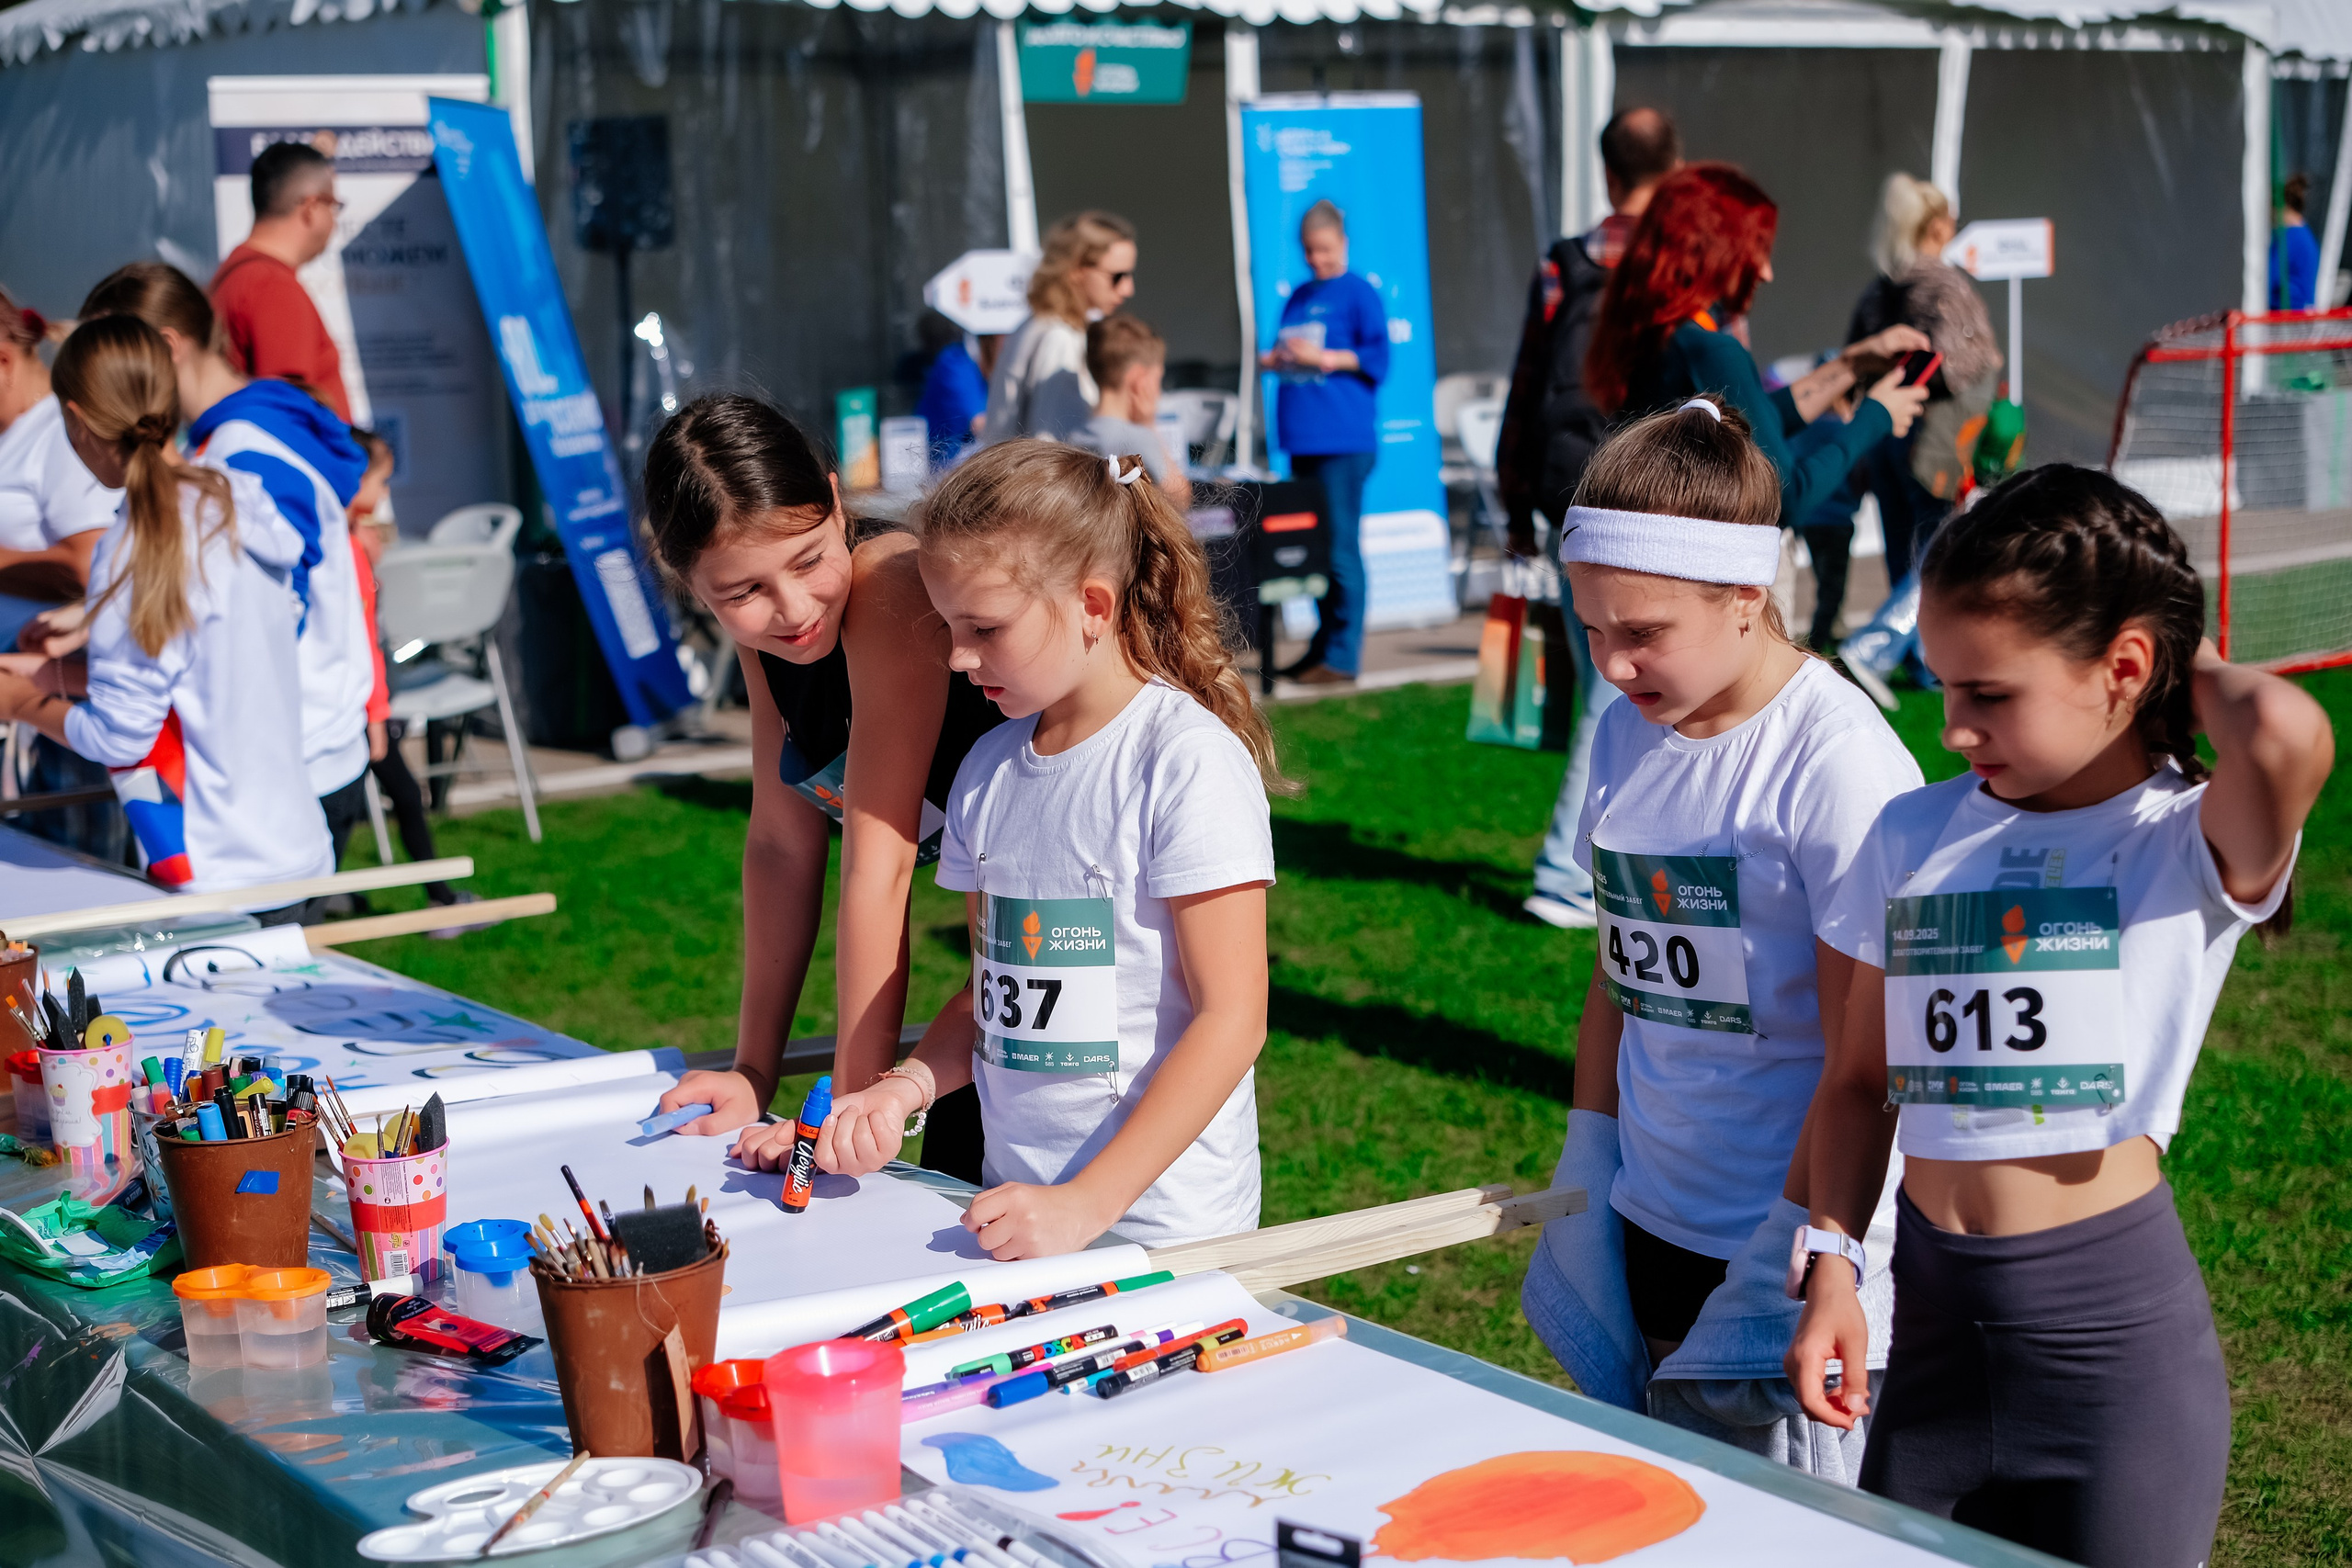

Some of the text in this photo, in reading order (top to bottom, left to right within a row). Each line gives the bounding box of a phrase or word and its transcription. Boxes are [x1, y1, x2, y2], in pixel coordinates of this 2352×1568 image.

[1679, 885, 1723, 897] ОГОНЬ
[1625, 897, 1643, 905] ЗАБЕГ
[1676, 897, 1728, 911] ЖИЗНИ
[1051, 927, 1102, 938] ОГОНЬ
[2039, 921, 2103, 936] ОГОНЬ
[1893, 928, 1939, 942] 14.09.2025
[997, 939, 1012, 948] ЗАБЕГ
[1048, 939, 1106, 951] ЖИЗНИ
[2035, 935, 2109, 953] ЖИЗНИ
[1608, 924, 1700, 989] 420
[1892, 945, 1984, 957] БЛАГОТВОРИТЕЛЬНЫЙ ЗАБЕГ
[980, 969, 1062, 1030] 637
[1662, 1008, 1683, 1018] MAER
[1719, 1015, 1742, 1024] DARS
[1925, 986, 2048, 1054] 613
[1016, 1053, 1039, 1062] MAER
[1992, 1082, 2024, 1091] MAER
[789, 1140, 816, 1194] Acrylic
[1030, 1335, 1086, 1361] POSCA
